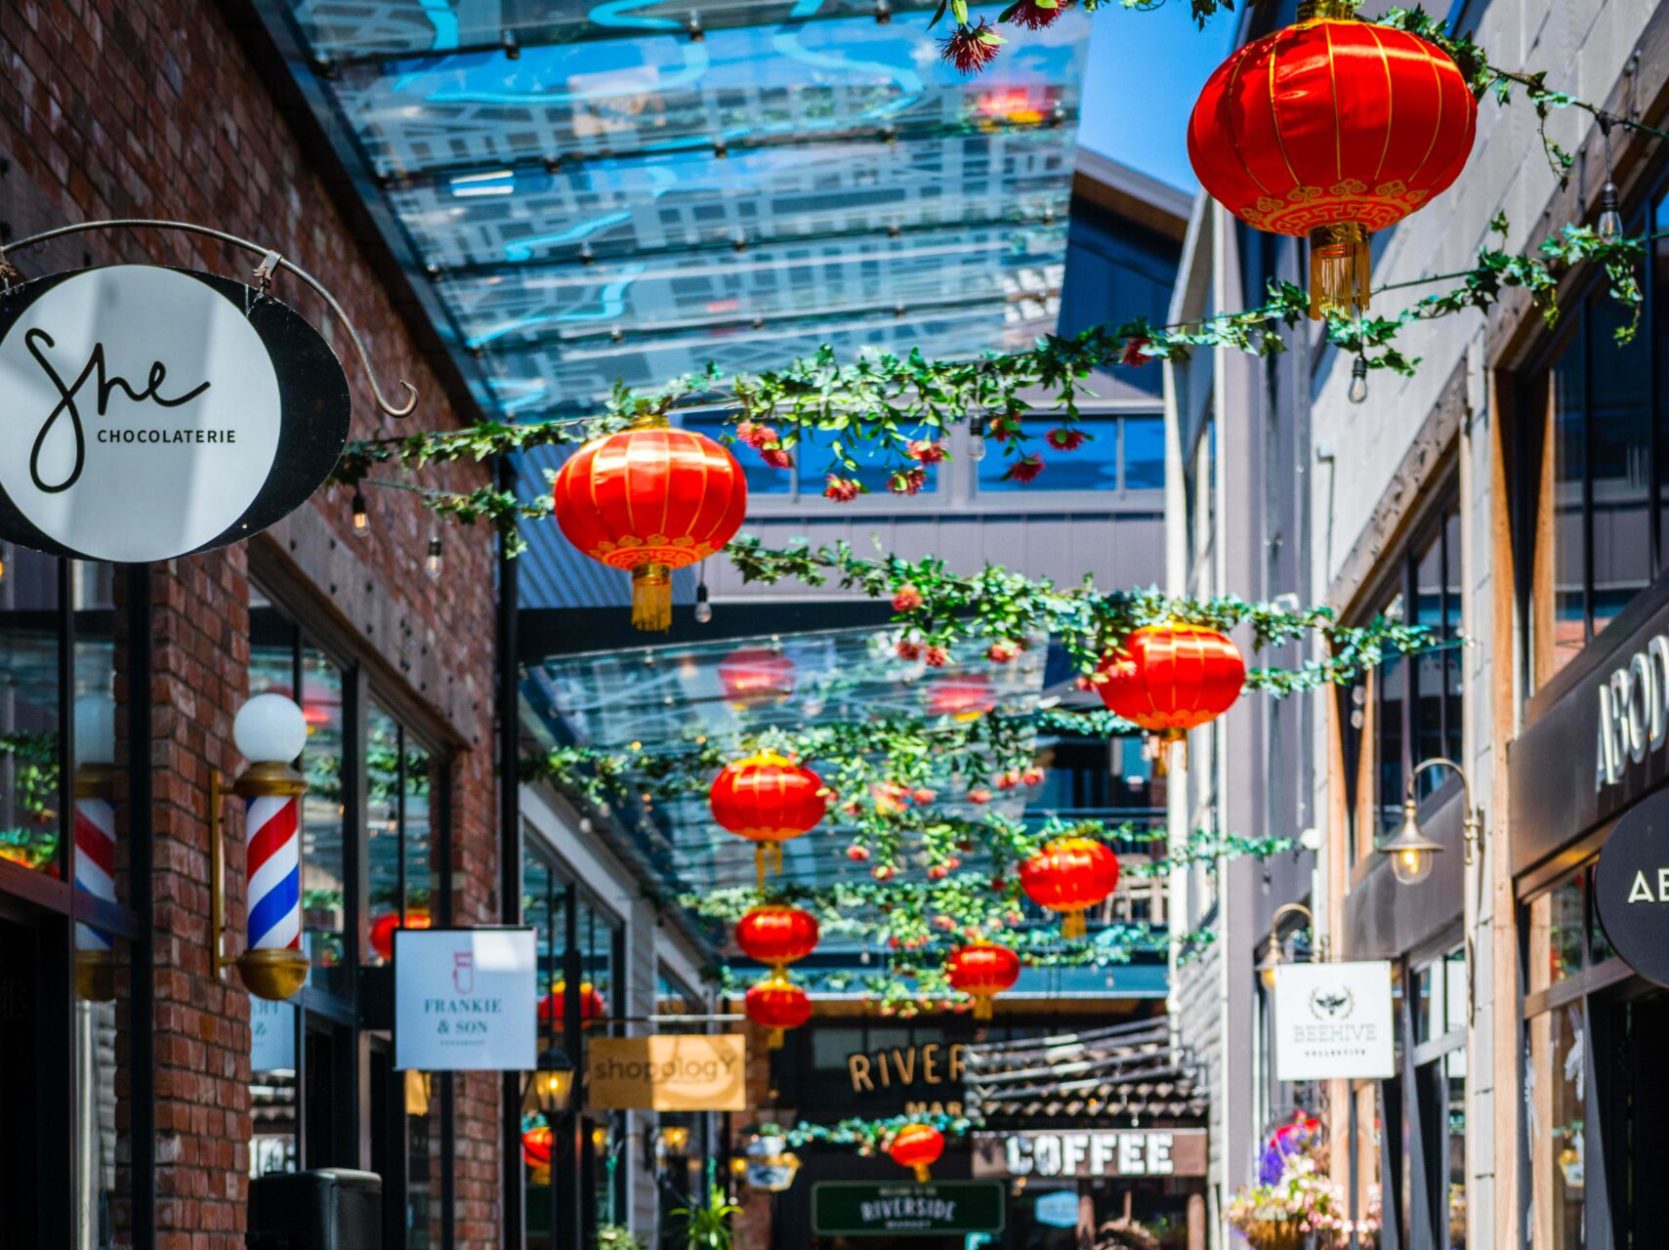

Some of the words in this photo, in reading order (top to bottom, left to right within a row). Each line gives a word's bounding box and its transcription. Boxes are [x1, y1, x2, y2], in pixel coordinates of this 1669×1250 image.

[25, 328, 211, 493] She
[97, 429, 236, 443] CHOCOLATERIE
[424, 999, 502, 1014] FRANKIE
[437, 1020, 449, 1034] &
[456, 1020, 487, 1034] SON
[1293, 1024, 1377, 1042] BEEHIVE
[1006, 1135, 1174, 1176] COFFEE
[861, 1196, 956, 1223] RIVERSIDE
